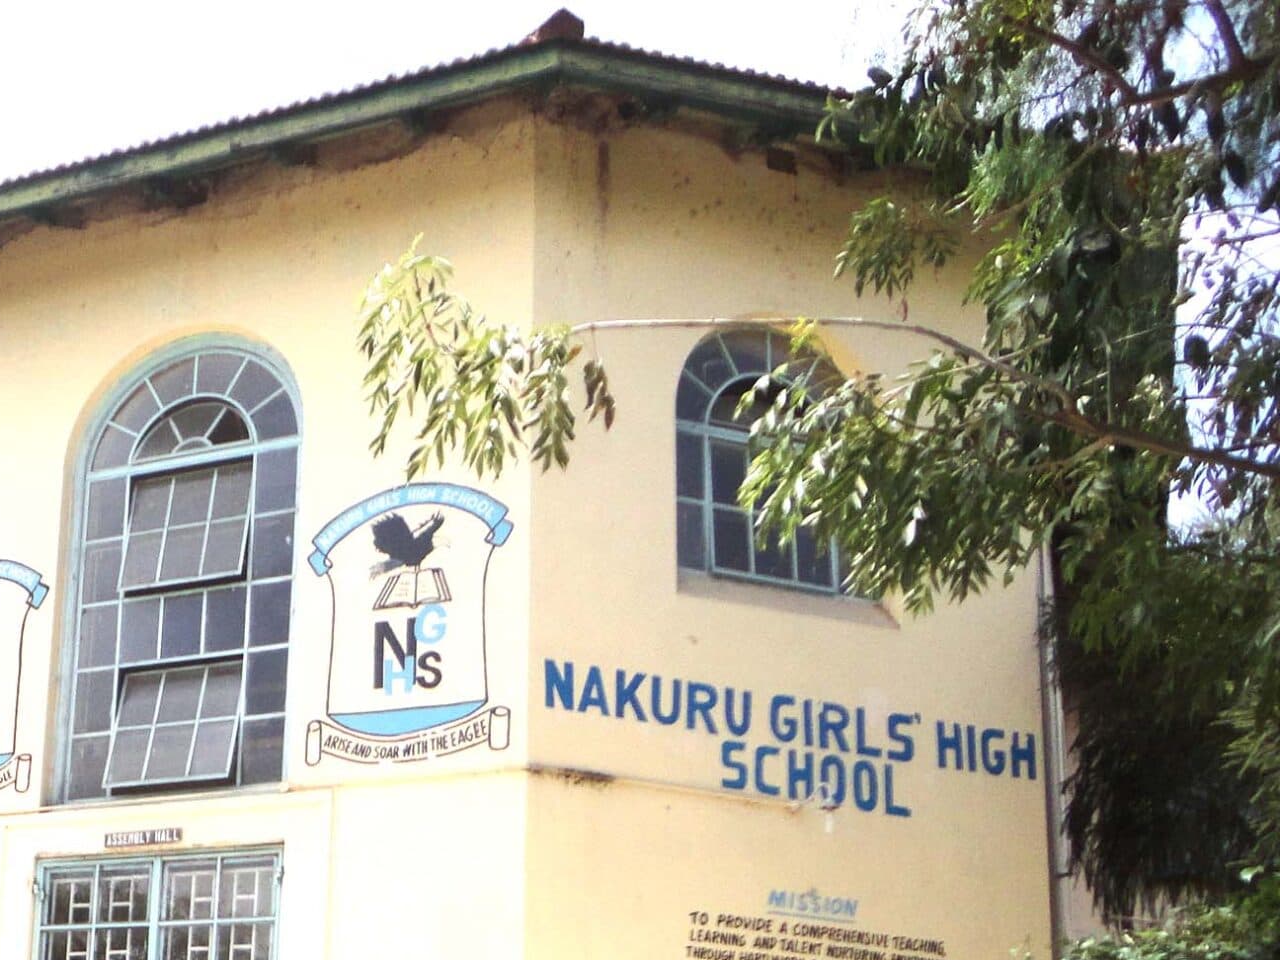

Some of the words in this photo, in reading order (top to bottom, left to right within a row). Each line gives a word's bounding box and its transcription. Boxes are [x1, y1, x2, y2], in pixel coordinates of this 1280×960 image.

[442, 486, 496, 520] SCHOOL
[544, 658, 752, 736] NAKURU
[935, 720, 1038, 780] HIGH
[323, 734, 352, 754] ARISE
[351, 744, 371, 759] AND
[373, 745, 400, 760] SOAR
[402, 741, 428, 758] WITH
[431, 734, 449, 750] THE
[721, 740, 912, 818] SCHOOL
[154, 829, 179, 842] HALL
[768, 889, 858, 917] MISSION
[688, 911, 709, 925] TO
[717, 914, 773, 933] PROVIDE
[780, 922, 788, 934] A
[793, 923, 889, 948] COMPREHENSIVE
[690, 929, 746, 947] LEARNING
[753, 937, 777, 950] AND
[780, 938, 823, 956] TALENT
